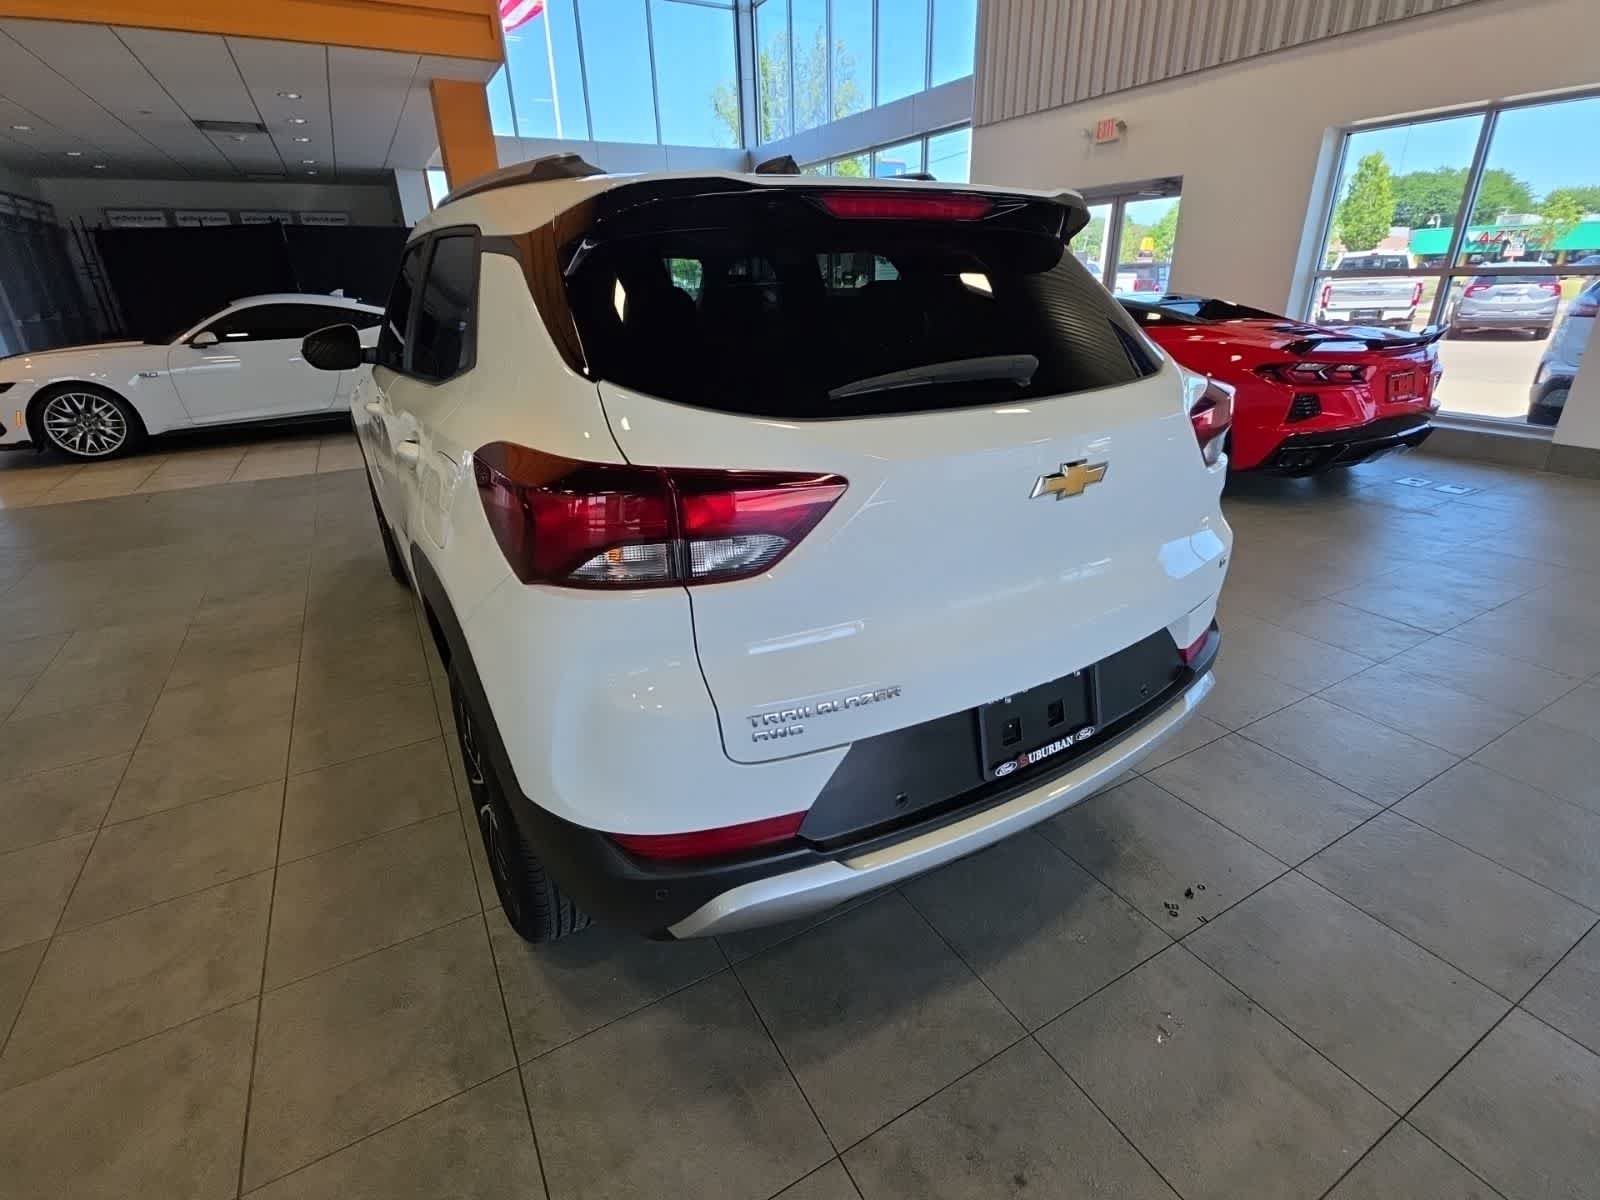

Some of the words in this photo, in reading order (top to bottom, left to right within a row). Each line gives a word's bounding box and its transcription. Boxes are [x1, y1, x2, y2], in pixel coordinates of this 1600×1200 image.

[746, 685, 902, 727] TRAILBLAZER
[752, 725, 804, 743] AWD
[1017, 735, 1075, 768] SUBURBAN
